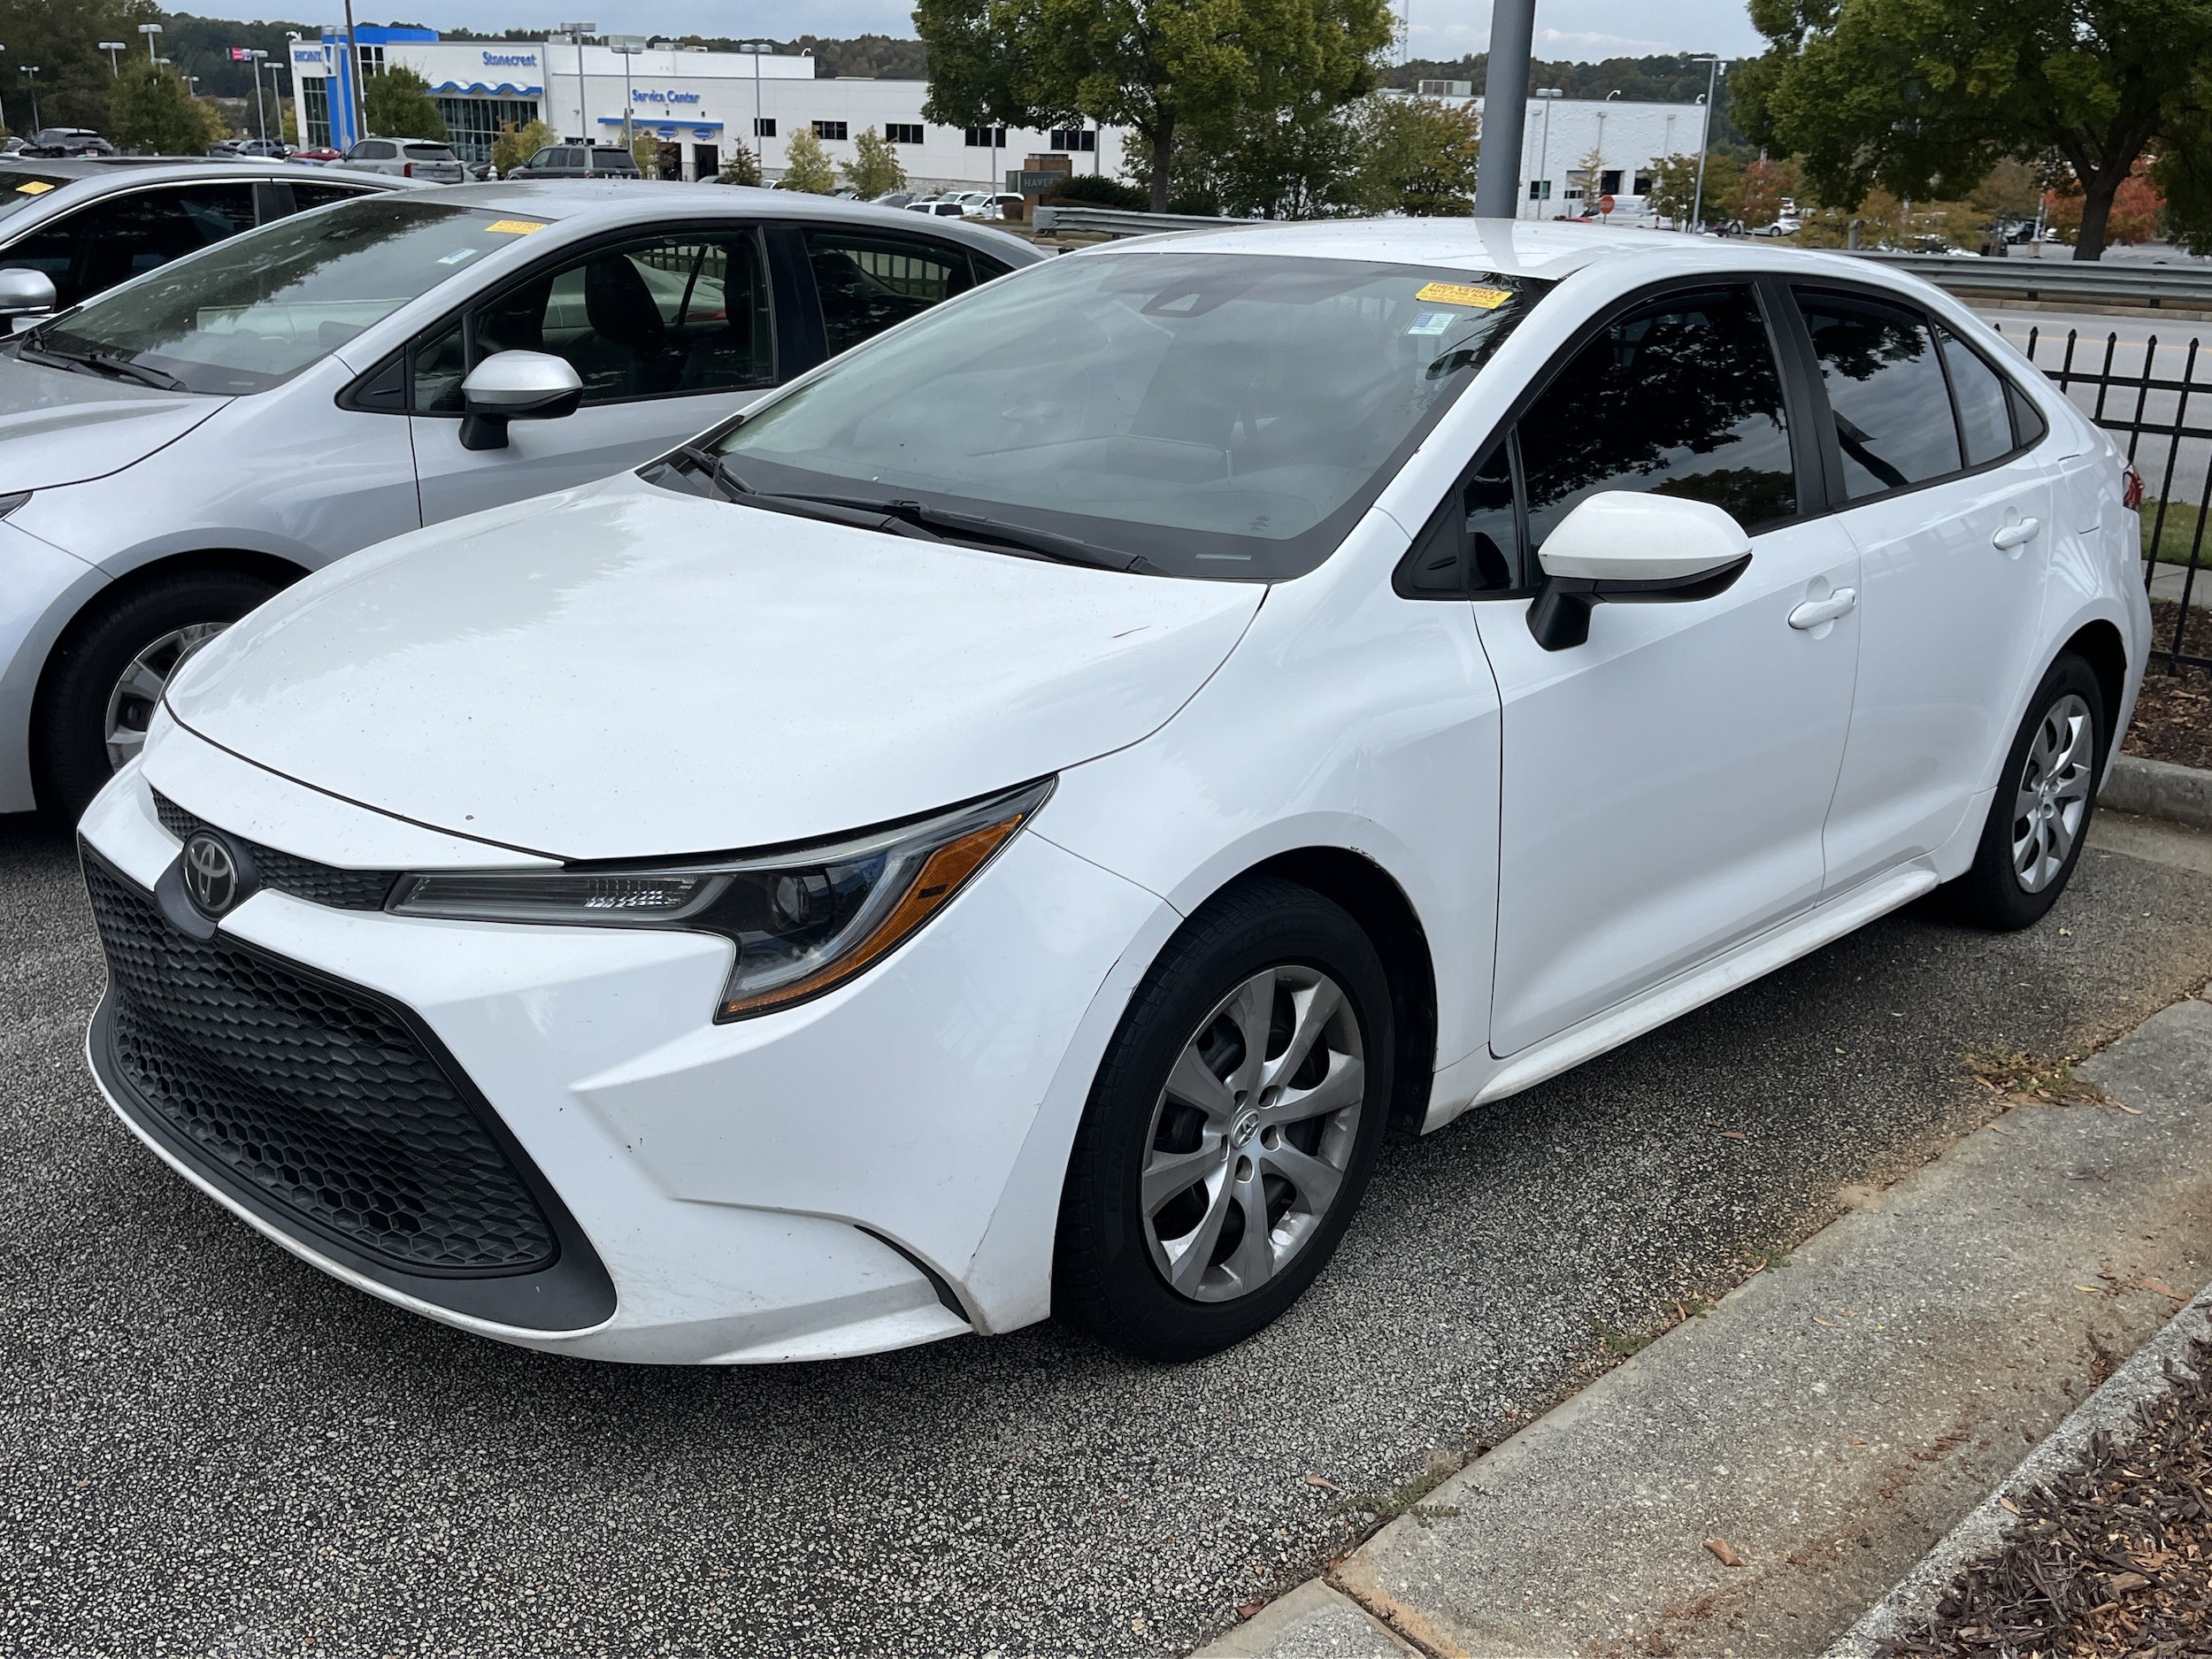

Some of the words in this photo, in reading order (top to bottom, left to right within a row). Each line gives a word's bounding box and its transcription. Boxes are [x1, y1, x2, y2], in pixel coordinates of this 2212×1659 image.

[482, 50, 537, 67] Stonecrest
[632, 89, 665, 103] Service
[667, 90, 701, 104] Center
[1458, 287, 1503, 296] VEHICLE
